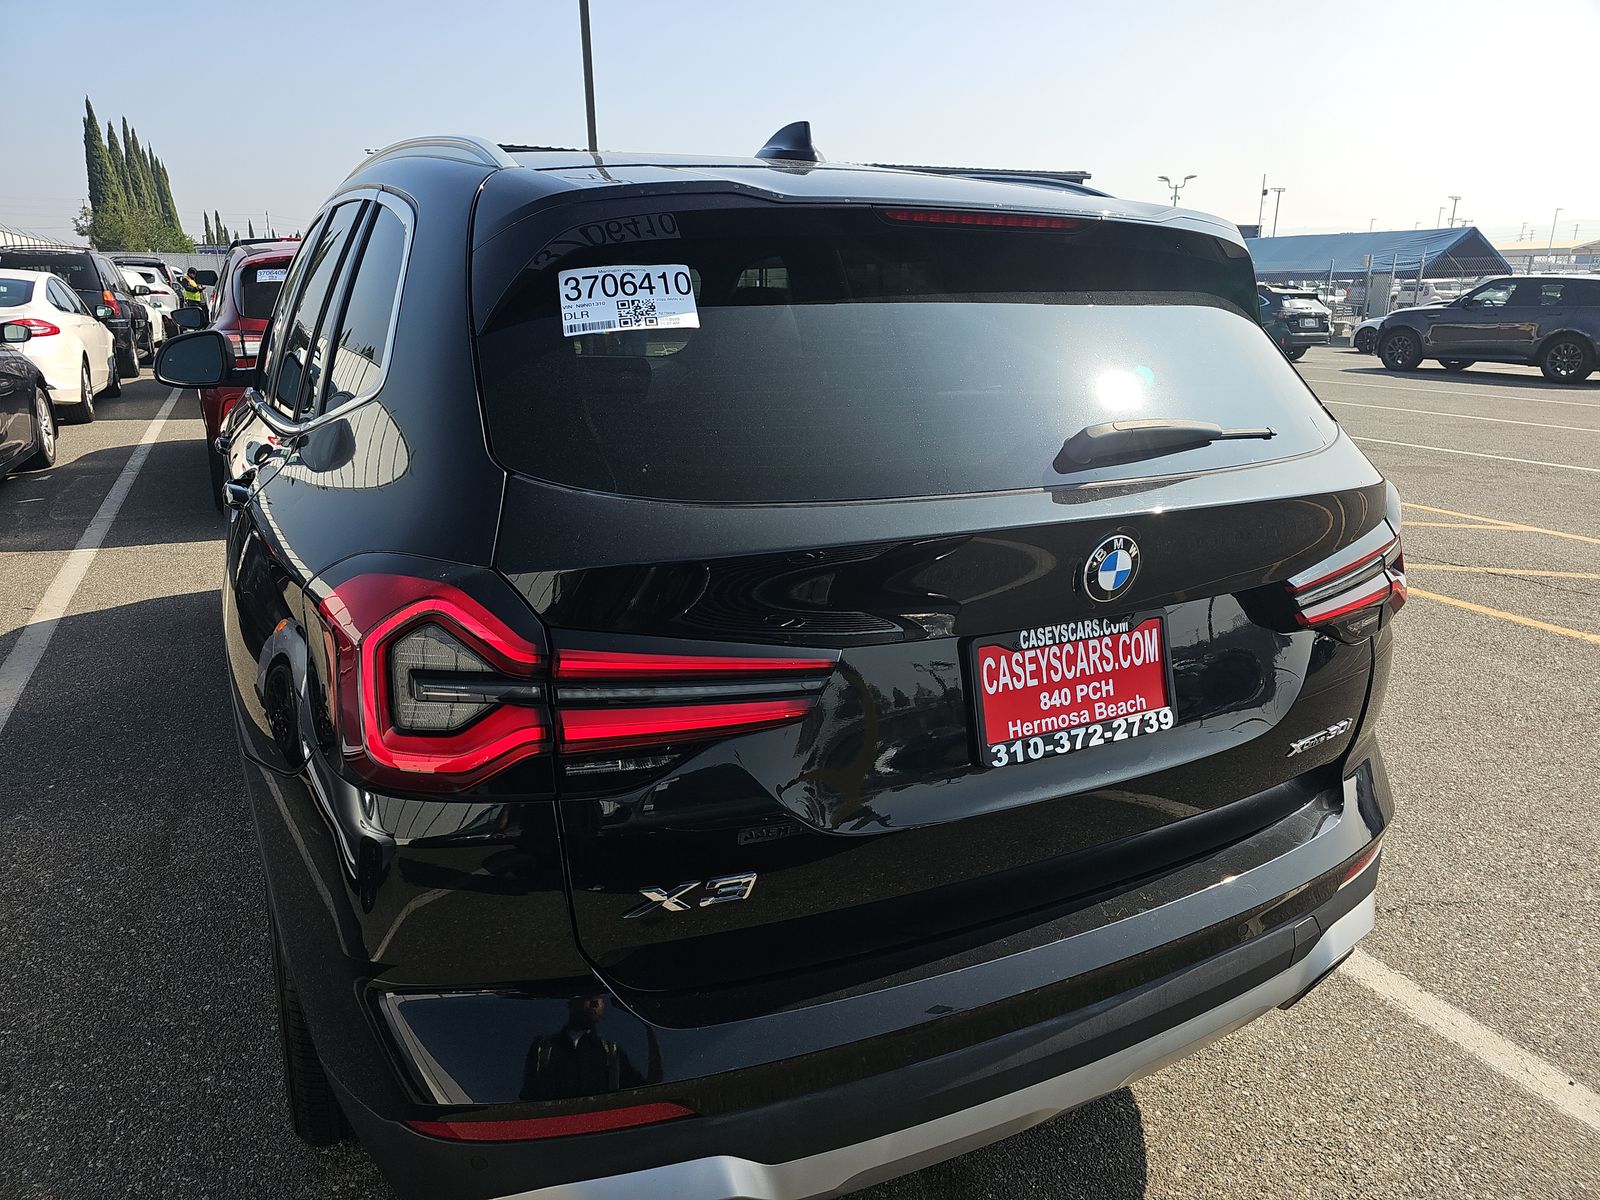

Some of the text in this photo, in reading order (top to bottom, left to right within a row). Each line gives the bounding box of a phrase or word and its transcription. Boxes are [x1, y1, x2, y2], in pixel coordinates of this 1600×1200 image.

[563, 271, 692, 302] 3706410
[563, 310, 590, 321] DLR
[1094, 537, 1138, 562] BMW
[1019, 617, 1130, 650] CASEYSCARS.COM
[982, 627, 1160, 695] CASEYSCARS.COM
[1039, 678, 1115, 711] 840 PCH
[1007, 694, 1147, 739] Hermosa Beach
[990, 708, 1175, 768] 310-372-2739
[620, 872, 758, 919] X3
